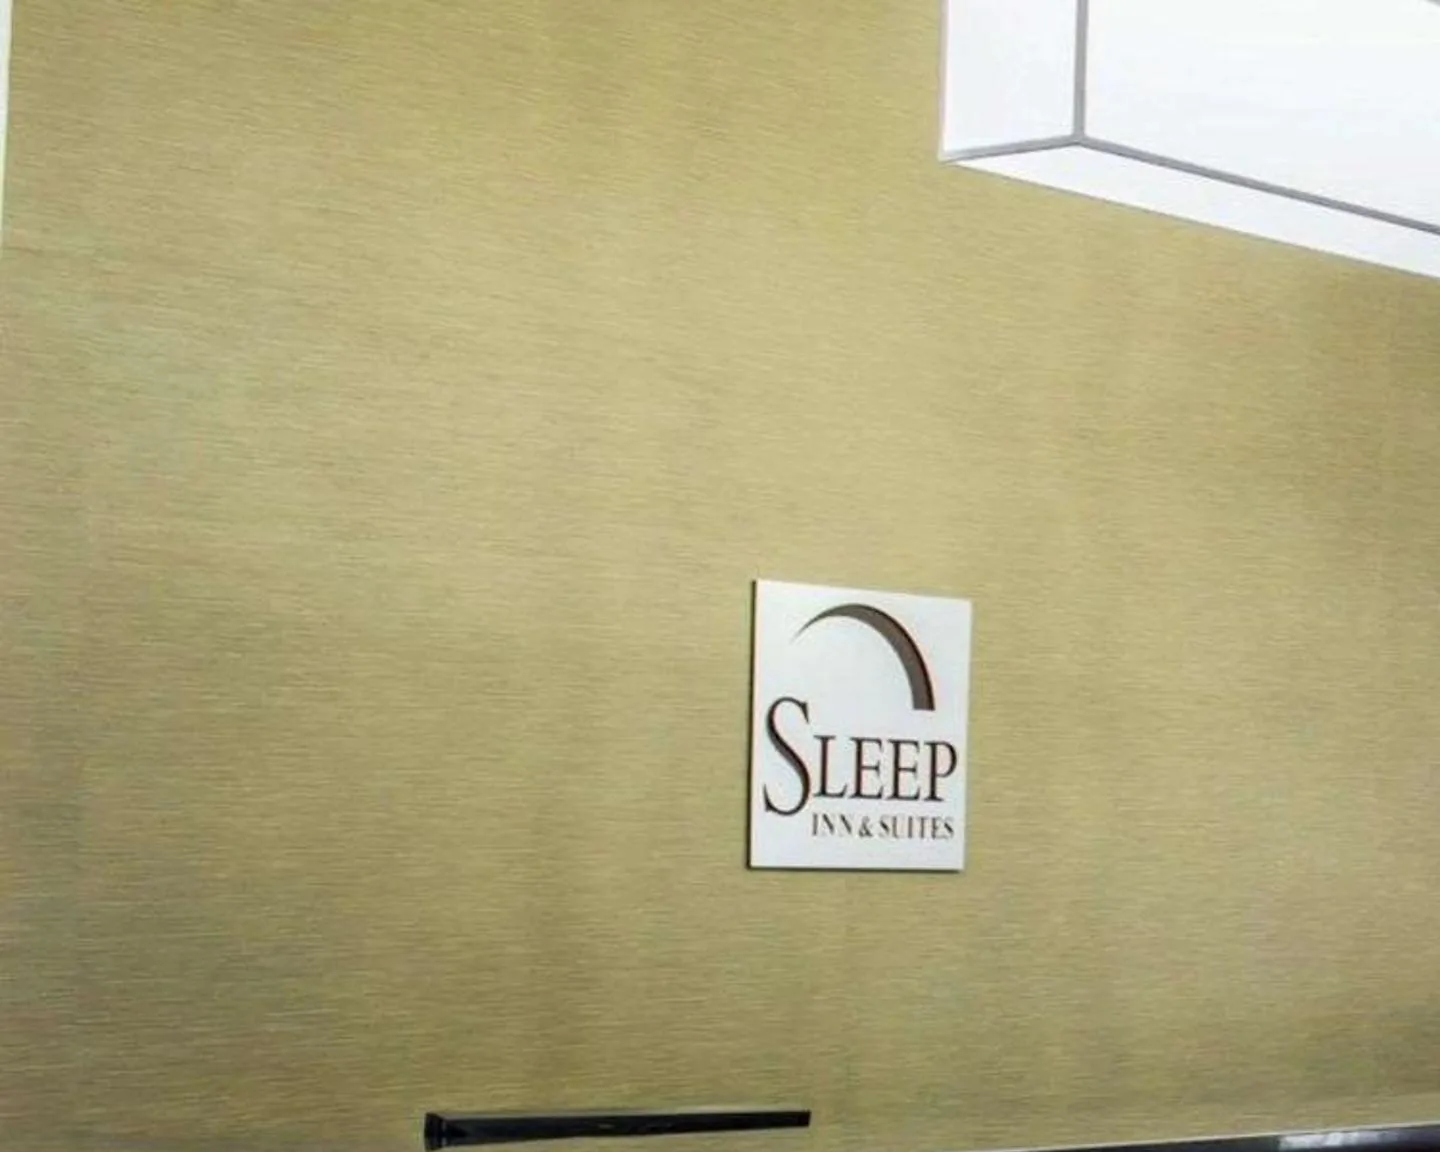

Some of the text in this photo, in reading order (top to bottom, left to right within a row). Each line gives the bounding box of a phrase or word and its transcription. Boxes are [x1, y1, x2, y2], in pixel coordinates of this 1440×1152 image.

[763, 696, 957, 816] SLEEP
[811, 812, 955, 840] INN & SUITES
